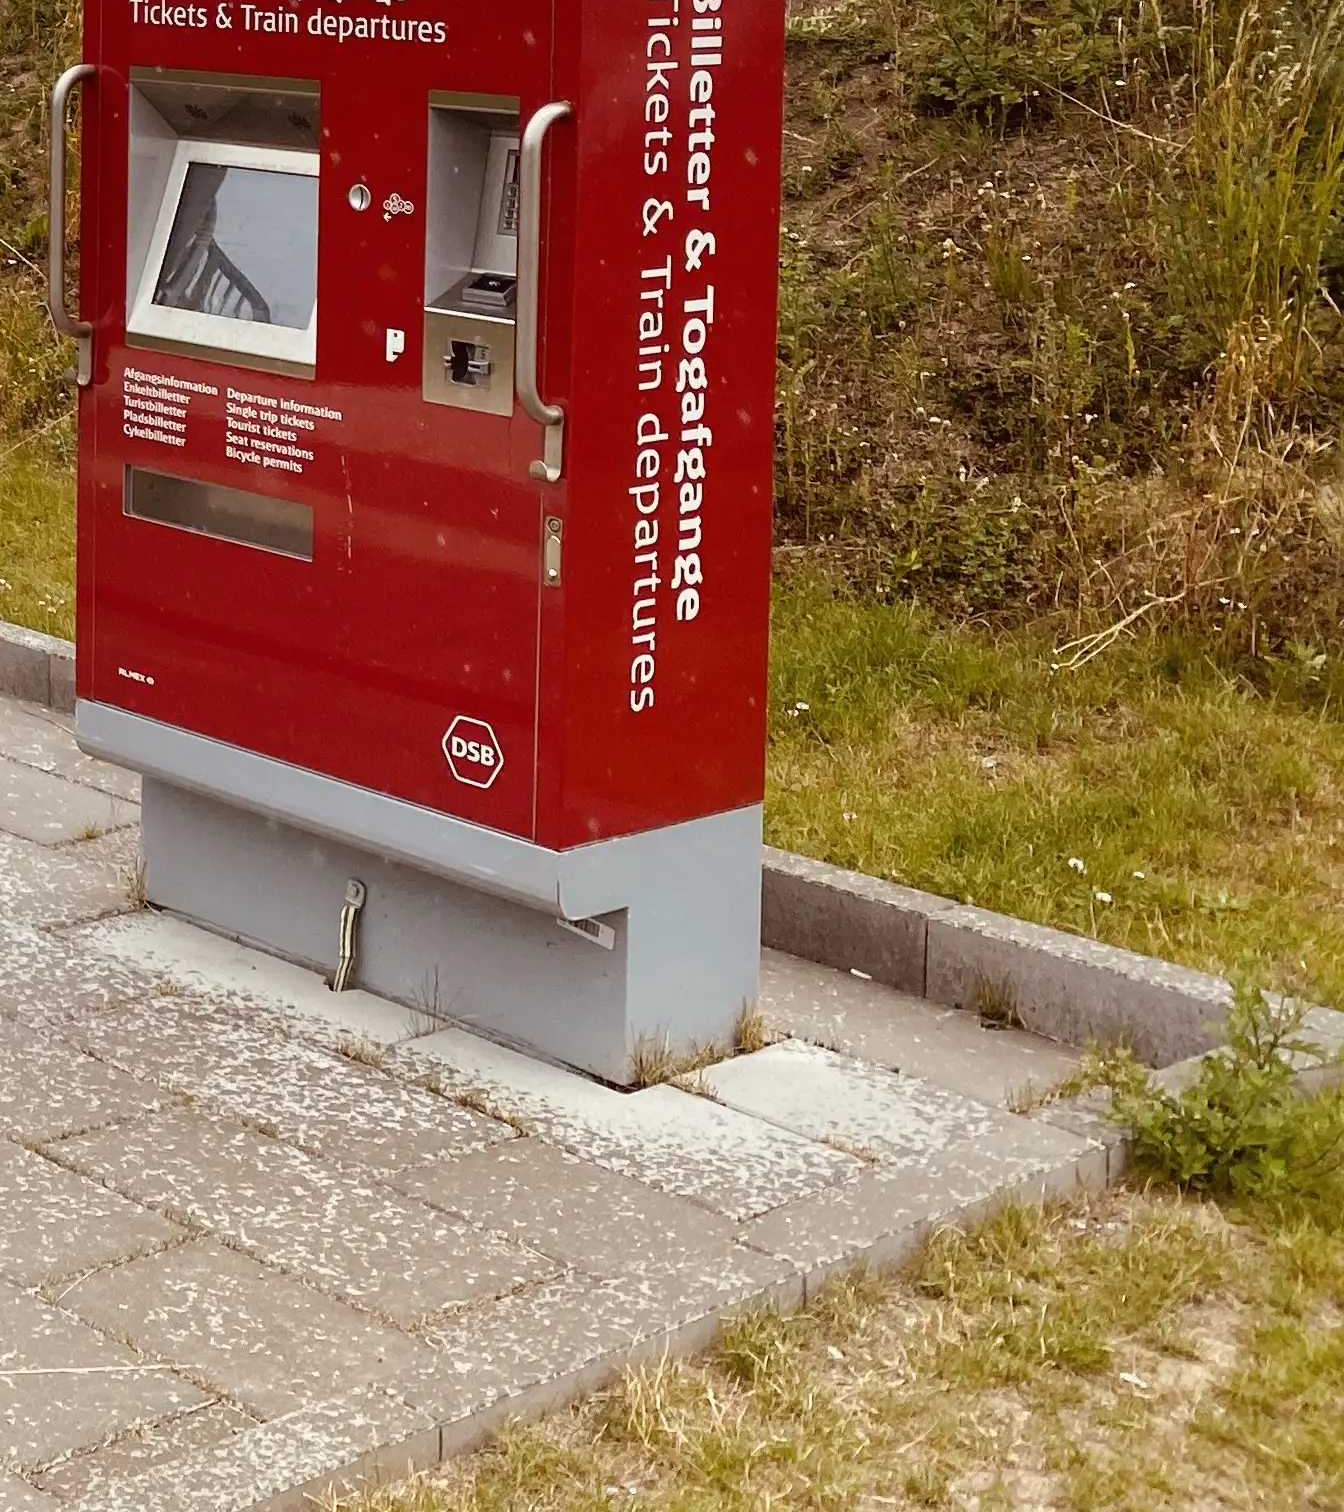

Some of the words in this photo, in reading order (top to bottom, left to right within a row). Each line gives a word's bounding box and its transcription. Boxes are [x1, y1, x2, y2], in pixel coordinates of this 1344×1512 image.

[215, 2, 233, 29] &
[241, 4, 299, 34] Train
[307, 8, 447, 43] departures
[642, 197, 674, 236] &
[684, 228, 716, 273] &
[637, 255, 672, 391] Train
[123, 367, 219, 396] Afgangsinformation
[123, 381, 191, 405] Enkeltbilletter
[123, 395, 187, 419] Turistbilletter
[226, 387, 278, 408] Departure
[280, 397, 343, 421] information
[226, 402, 257, 420] Single
[259, 409, 278, 425] trip
[280, 413, 315, 431] tickets
[123, 409, 186, 433] Pladsbilletter
[123, 423, 186, 447] Cykelbilletter
[226, 417, 261, 435] Tourist
[263, 425, 297, 442] tickets
[226, 431, 248, 446] Seat
[250, 438, 314, 461] reservations
[226, 446, 261, 465] Bicycle
[263, 455, 303, 473] permits
[670, 284, 714, 622] Togafgange
[628, 412, 669, 713] departures
[451, 736, 495, 767] DSB
